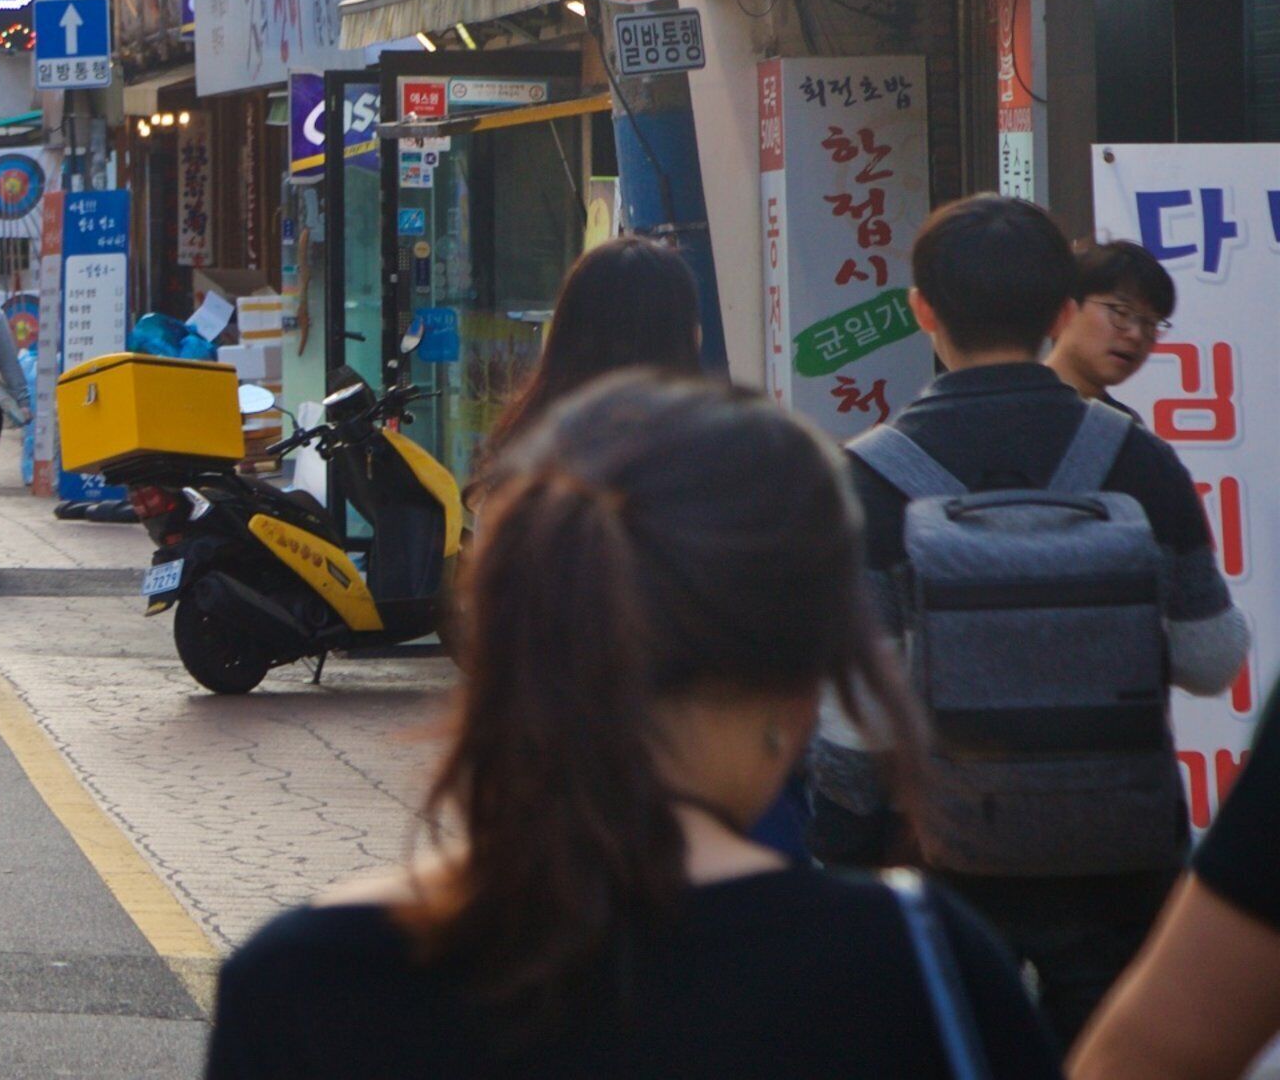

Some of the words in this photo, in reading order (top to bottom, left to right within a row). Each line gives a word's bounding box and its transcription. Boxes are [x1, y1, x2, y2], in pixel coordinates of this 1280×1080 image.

[39, 62, 110, 83] 일방통행
[619, 22, 702, 73] 일방통행
[799, 74, 913, 110] 회전초밥
[821, 125, 894, 288] 한접시
[814, 296, 910, 362] 균일가
